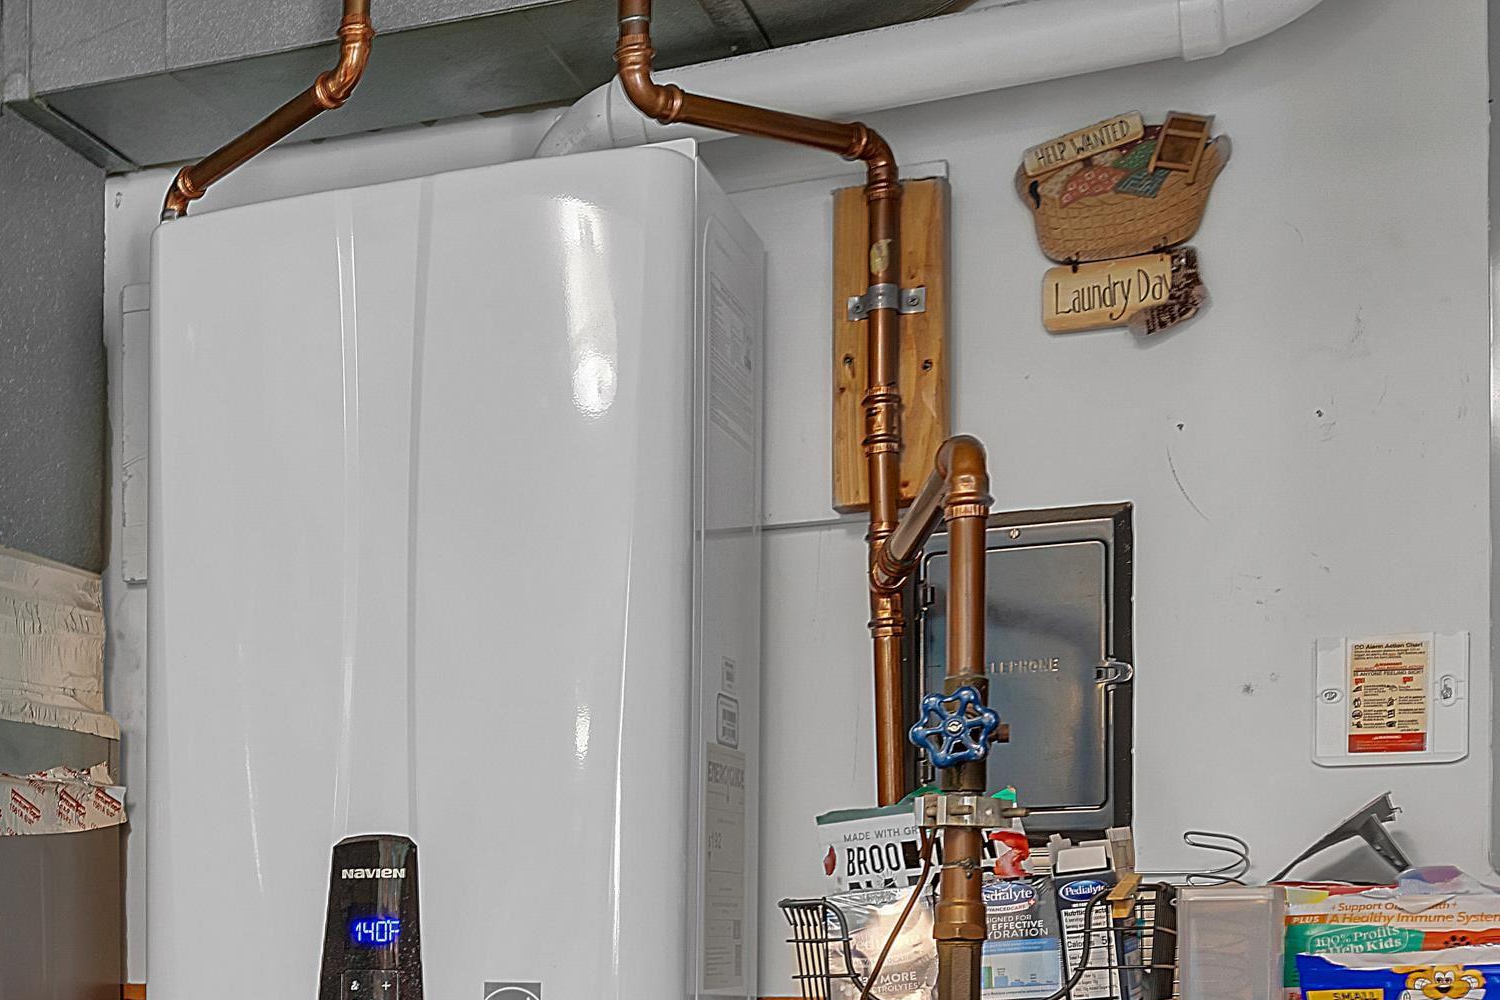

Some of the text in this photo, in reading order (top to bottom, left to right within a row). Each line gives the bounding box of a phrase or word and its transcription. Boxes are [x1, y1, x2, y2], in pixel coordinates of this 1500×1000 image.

[1034, 120, 1130, 167] HELP WANTED
[1054, 274, 1131, 321] Laundry
[843, 828, 870, 842] MADE
[874, 828, 900, 840] WITH
[983, 888, 1034, 902] edialyte
[1338, 902, 1381, 913] Support
[992, 920, 1044, 931] EFFECTIVE
[1292, 916, 1320, 924] PLUS
[1329, 914, 1340, 924] A
[1341, 912, 1393, 925] Healthy
[1396, 912, 1452, 922] Immune
[987, 928, 1048, 940] YDRATION
[1315, 927, 1400, 948] 100% Profits
[1366, 937, 1402, 952] Kids
[881, 970, 917, 984] MORE
[1333, 992, 1380, 1000] SMALL
